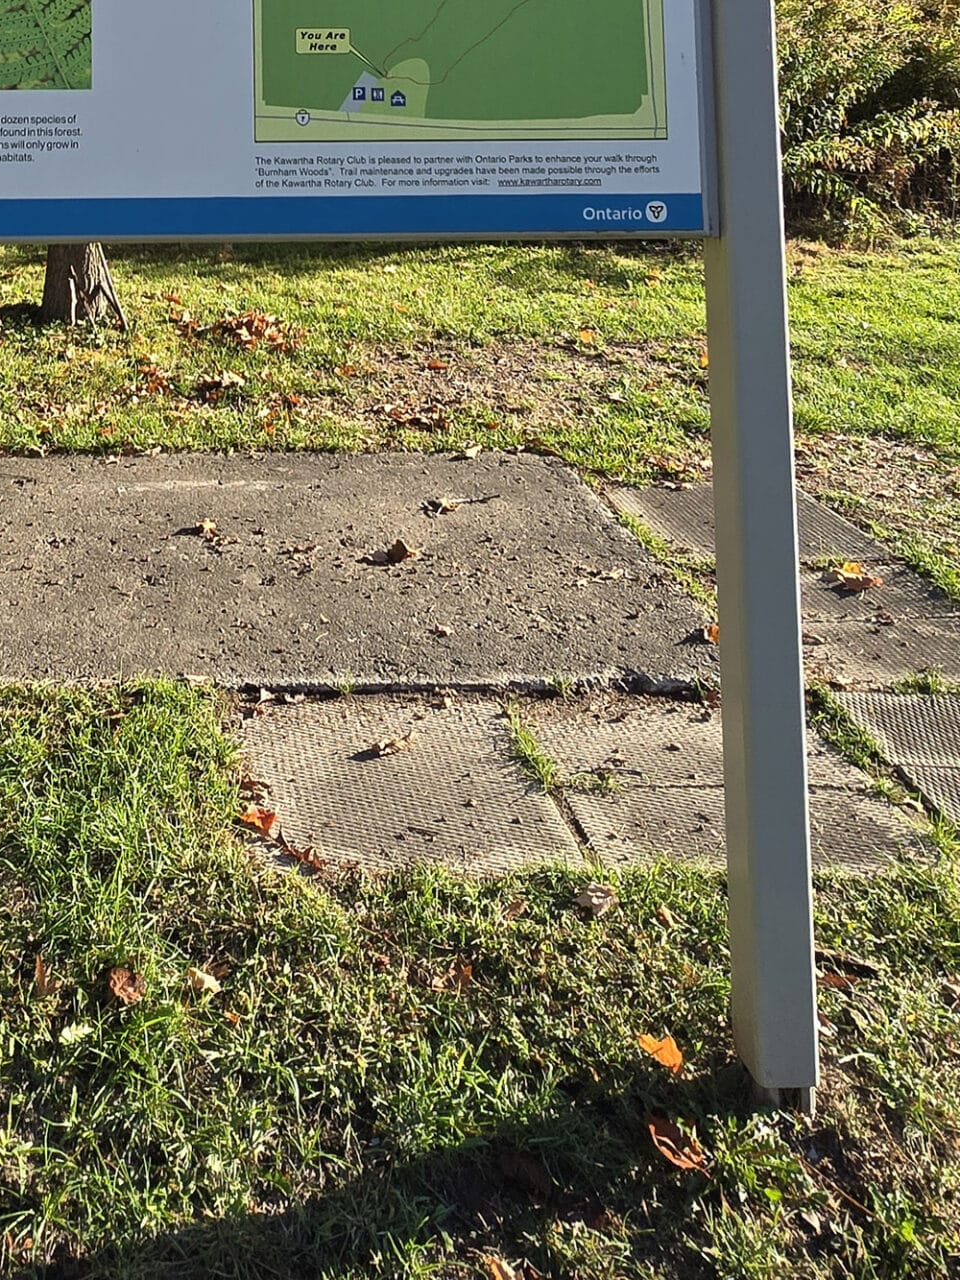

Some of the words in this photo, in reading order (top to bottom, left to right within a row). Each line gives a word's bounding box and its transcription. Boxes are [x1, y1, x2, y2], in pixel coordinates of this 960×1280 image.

[300, 32, 321, 40] You
[326, 32, 346, 40] Are
[310, 43, 337, 51] Here
[0, 114, 29, 124] dozen
[30, 115, 66, 126] species
[0, 127, 26, 137] found
[36, 127, 53, 137] this
[54, 127, 82, 136] forest.
[10, 140, 24, 149] will
[26, 139, 45, 152] only
[46, 141, 69, 151] grow
[266, 178, 279, 187] the
[281, 178, 321, 187] Kawartha
[324, 178, 352, 189] Rotary
[354, 178, 376, 187] Club.
[381, 178, 395, 186] For
[422, 177, 469, 186] information
[471, 177, 490, 186] visit:
[583, 207, 642, 220] Ontario
